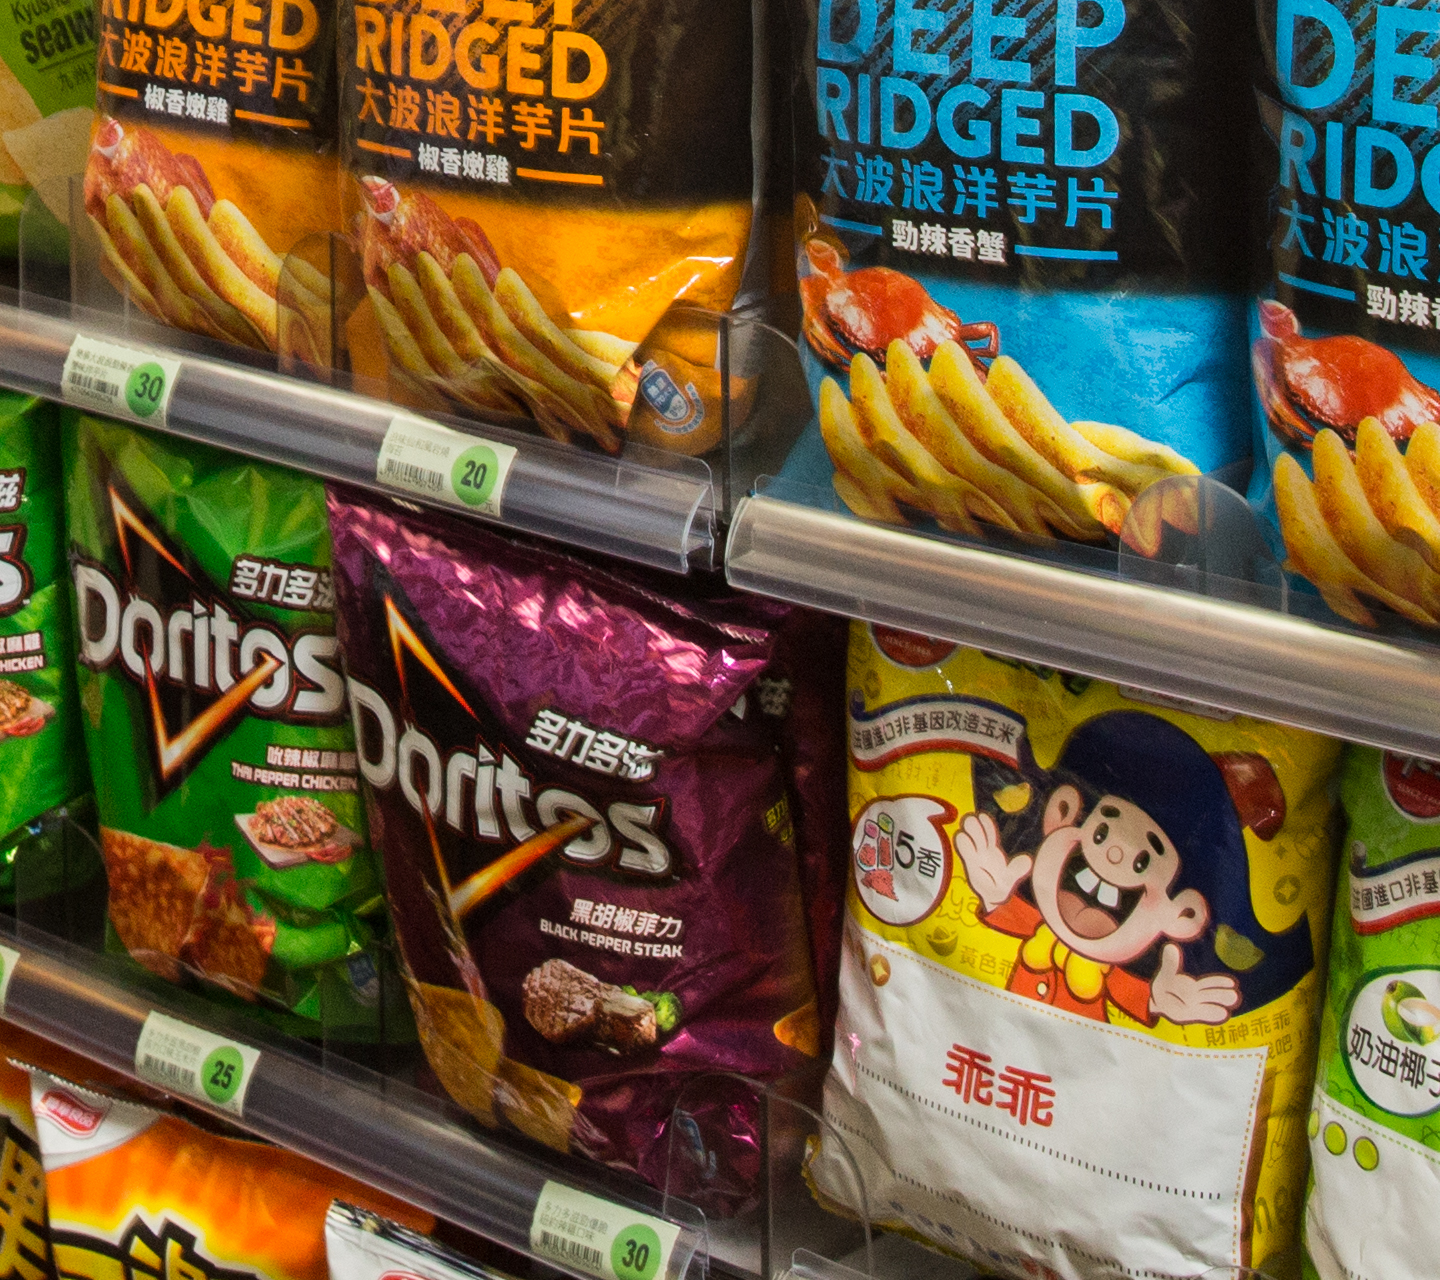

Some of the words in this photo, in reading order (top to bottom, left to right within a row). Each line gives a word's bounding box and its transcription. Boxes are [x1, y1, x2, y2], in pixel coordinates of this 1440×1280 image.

[98, 28, 315, 104] 大波浪洋芋片
[355, 5, 609, 100] RIDGED
[144, 81, 229, 127] 椒香嫩雞
[355, 77, 607, 157] 大波浪洋芋片
[817, 69, 1120, 170] RIDGED
[417, 142, 510, 185] 椒香嫩雞
[819, 153, 1120, 231] 大波浪洋芋片
[891, 217, 1007, 267] 勁辣香蟹
[134, 372, 164, 403] 30
[460, 459, 488, 490] 20
[73, 562, 346, 715] Doritos
[231, 761, 253, 781] THAI
[253, 766, 300, 788] PEPPER
[301, 772, 359, 791] CHICKEN
[346, 676, 677, 878] Doritos
[539, 917, 578, 942] BLACK
[579, 929, 632, 955] PEPPER
[633, 941, 683, 959] STEAK
[569, 897, 683, 939] 黑胡椒菲力
[209, 1059, 237, 1090] 25
[941, 1043, 1056, 1129] 乖乖
[621, 1238, 650, 1272] 30
